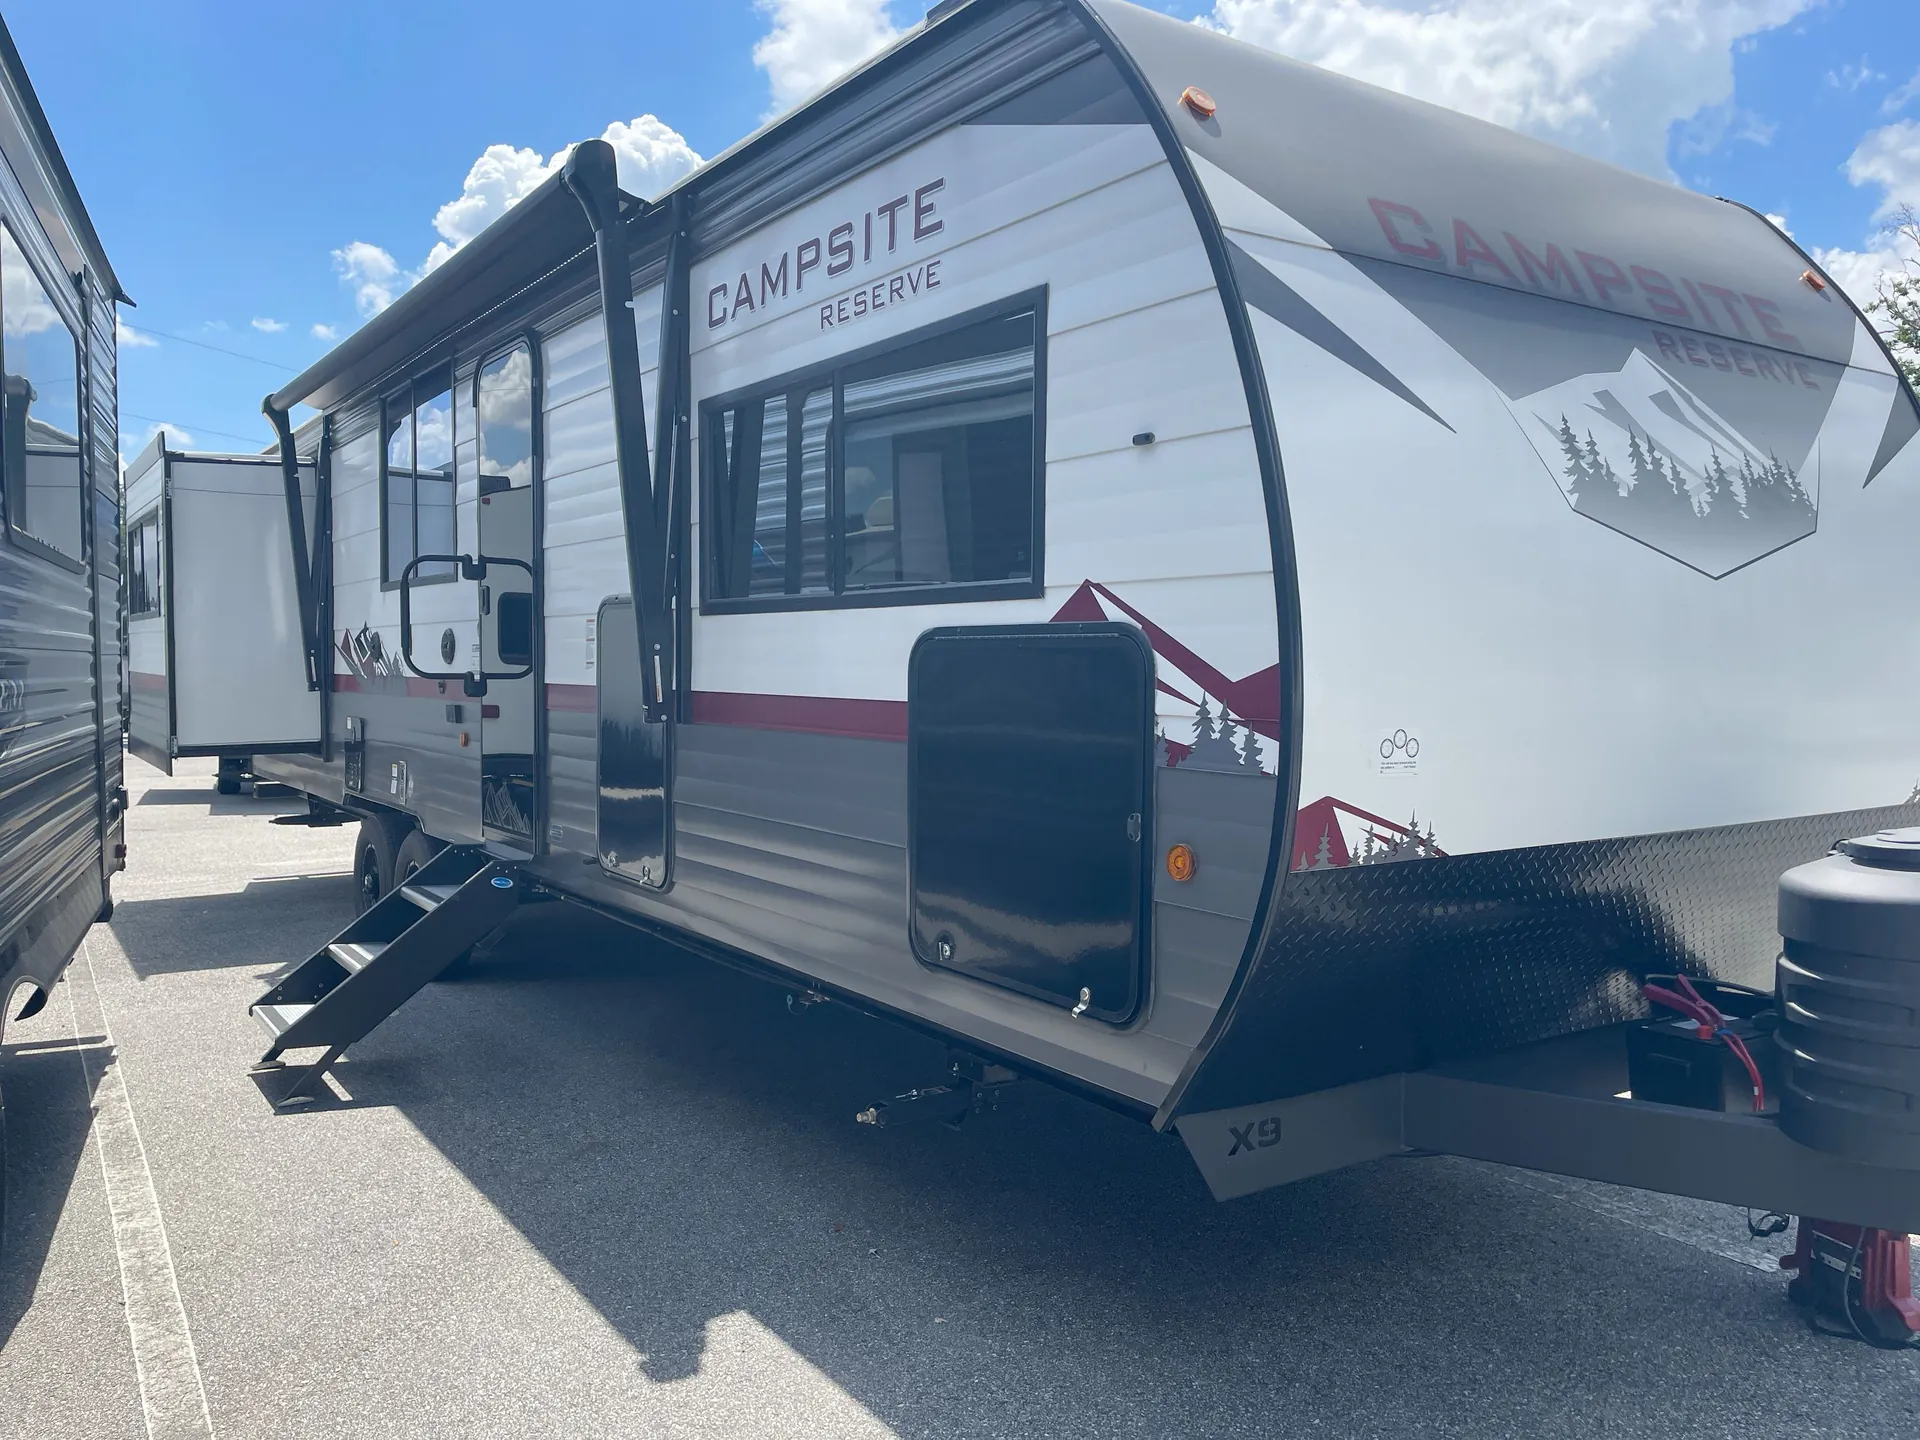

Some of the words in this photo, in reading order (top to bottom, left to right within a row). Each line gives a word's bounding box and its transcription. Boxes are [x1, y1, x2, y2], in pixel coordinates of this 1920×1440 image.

[708, 177, 945, 329] CAMPSITE
[1368, 197, 1801, 344] CAMPSITE
[820, 260, 942, 330] RESERVE
[1652, 329, 1821, 392] RESERVE
[1227, 1116, 1282, 1157] X9
